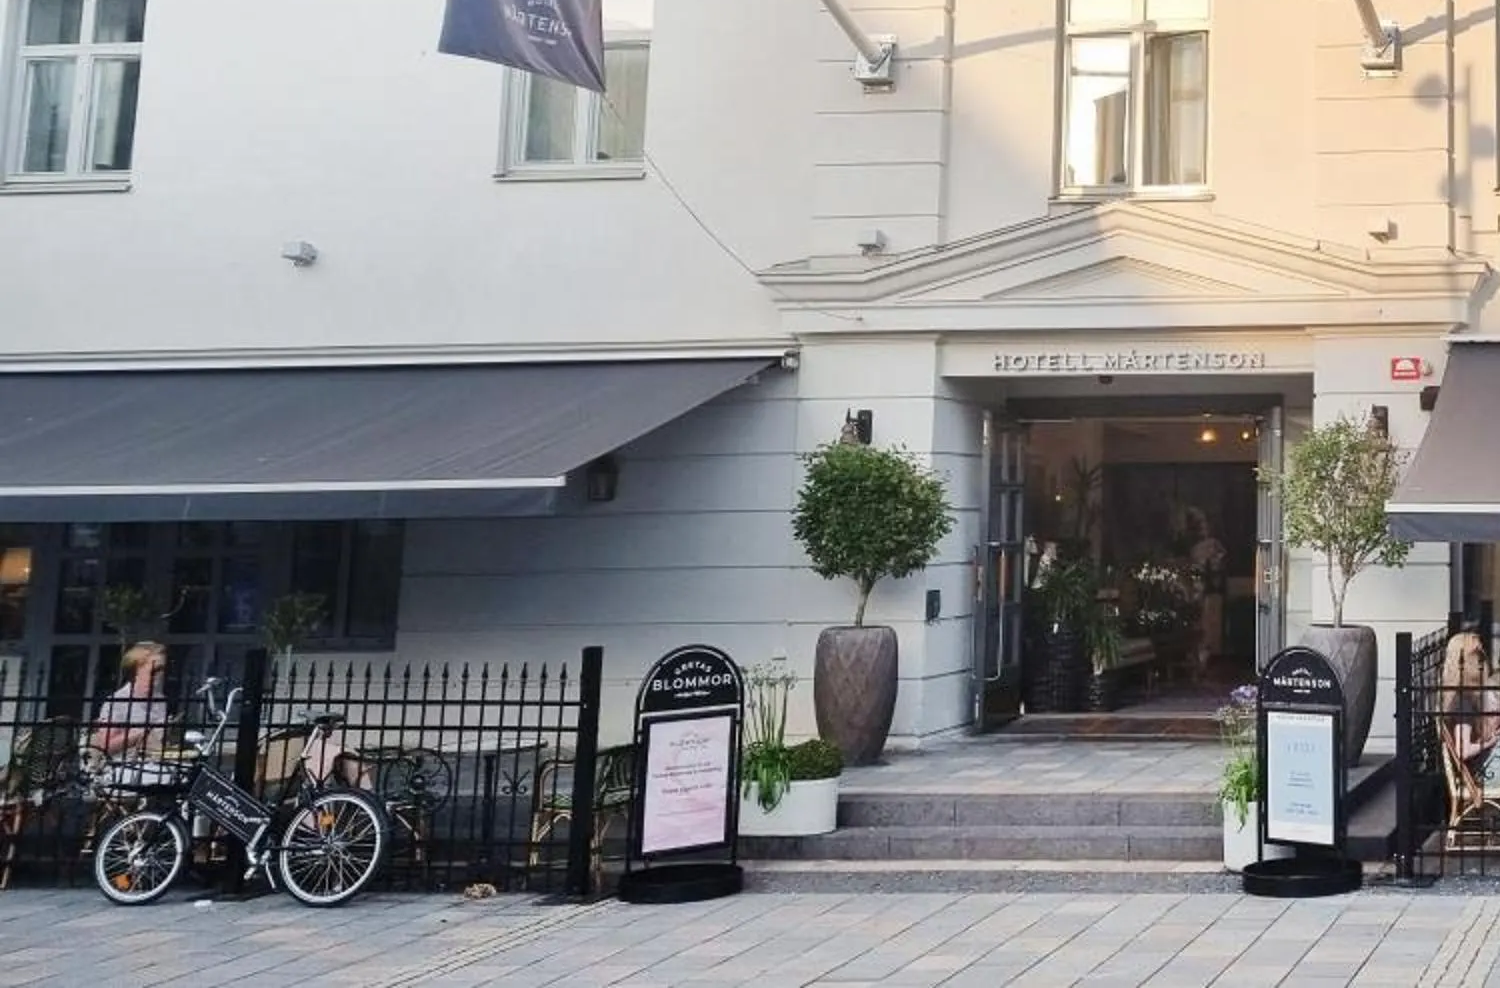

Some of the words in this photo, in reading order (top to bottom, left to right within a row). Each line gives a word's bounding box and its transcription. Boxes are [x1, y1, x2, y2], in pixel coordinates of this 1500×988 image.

[993, 353, 1093, 372] HOTELL
[1103, 349, 1266, 371] MÅRTENSON
[652, 673, 732, 691] BLOMMOR
